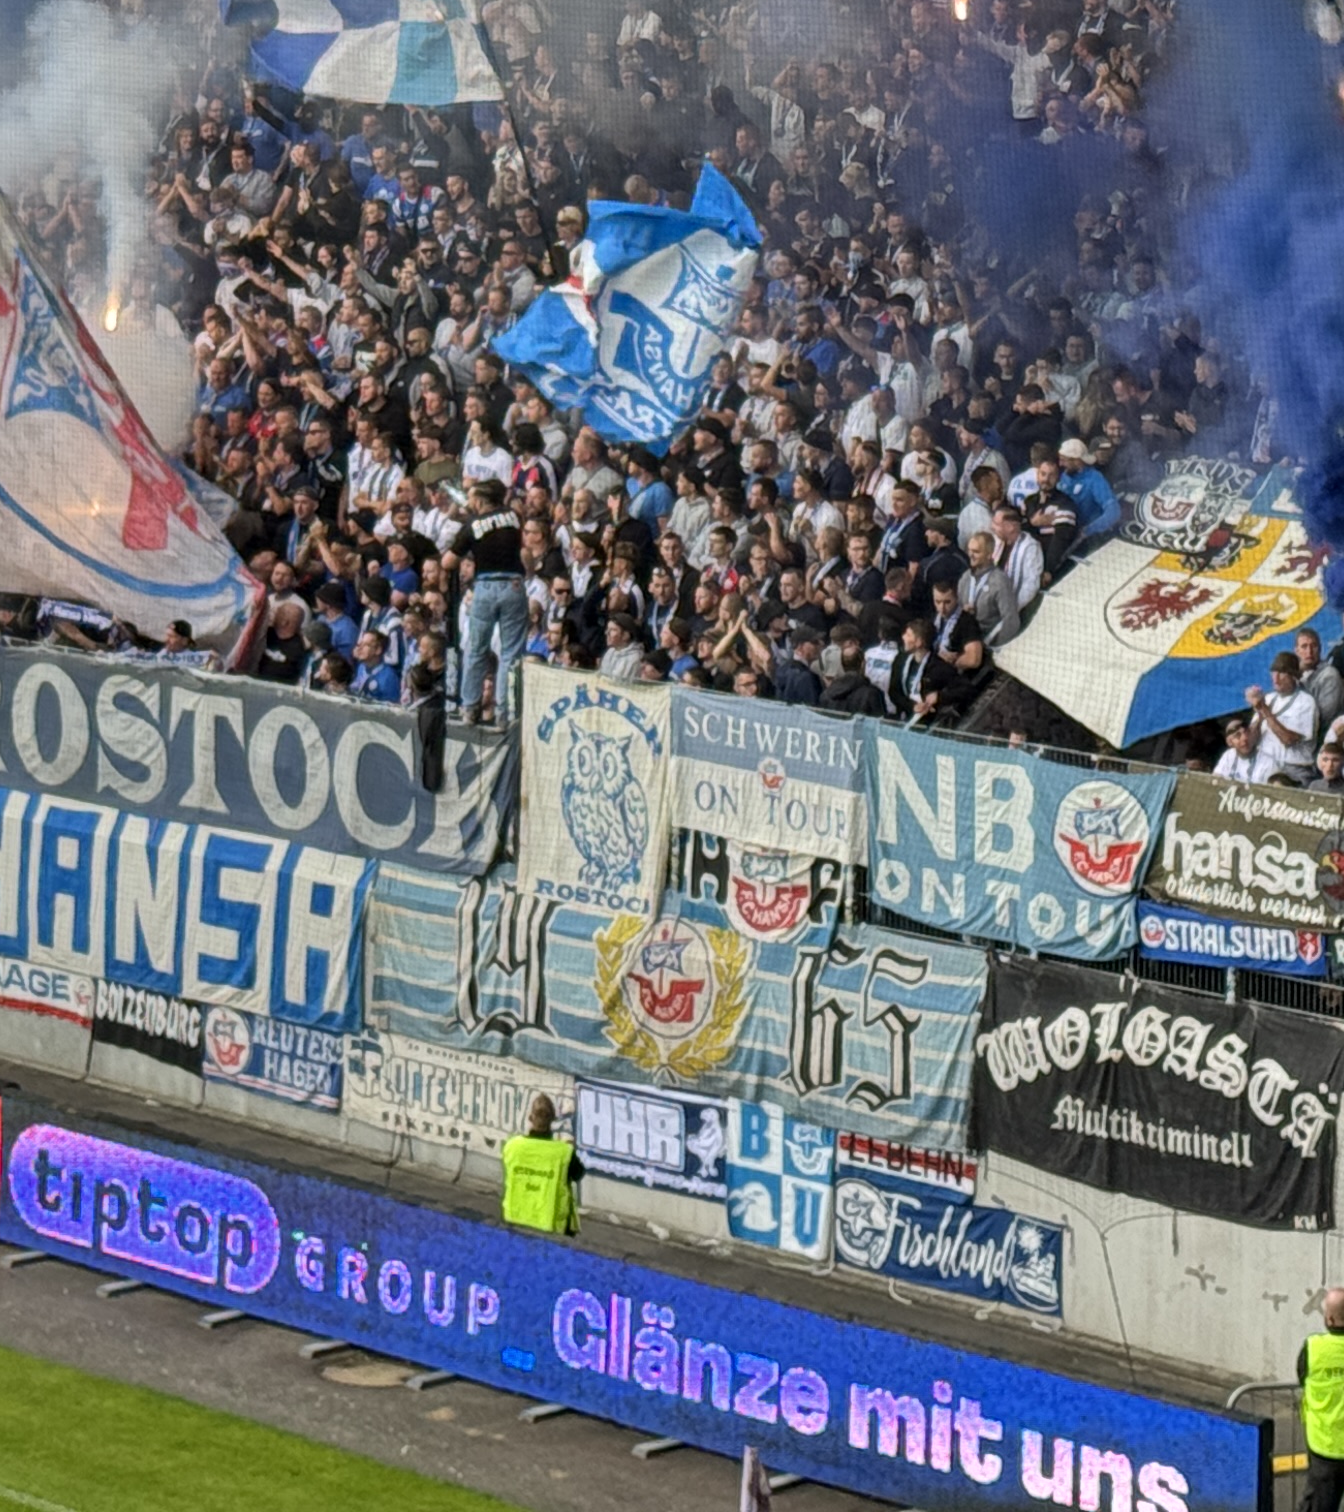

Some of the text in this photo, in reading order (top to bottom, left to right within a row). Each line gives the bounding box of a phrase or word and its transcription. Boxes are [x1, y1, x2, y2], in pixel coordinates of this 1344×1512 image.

[683, 705, 863, 771] SCHWERIN
[694, 780, 740, 816] ON
[874, 736, 1036, 874] NB
[874, 858, 966, 919] ON
[1163, 811, 1321, 900] hansa
[1164, 918, 1298, 963] STRALSUND
[96, 980, 202, 1048] BOIZENBURG
[739, 1102, 771, 1162] B
[1049, 1094, 1254, 1169] Multikriminell
[33, 1148, 501, 1337] tiptop GROUP
[792, 1183, 822, 1250] U
[869, 1190, 1016, 1291] Fischland
[551, 1288, 1192, 1512] Glänze mit uns
